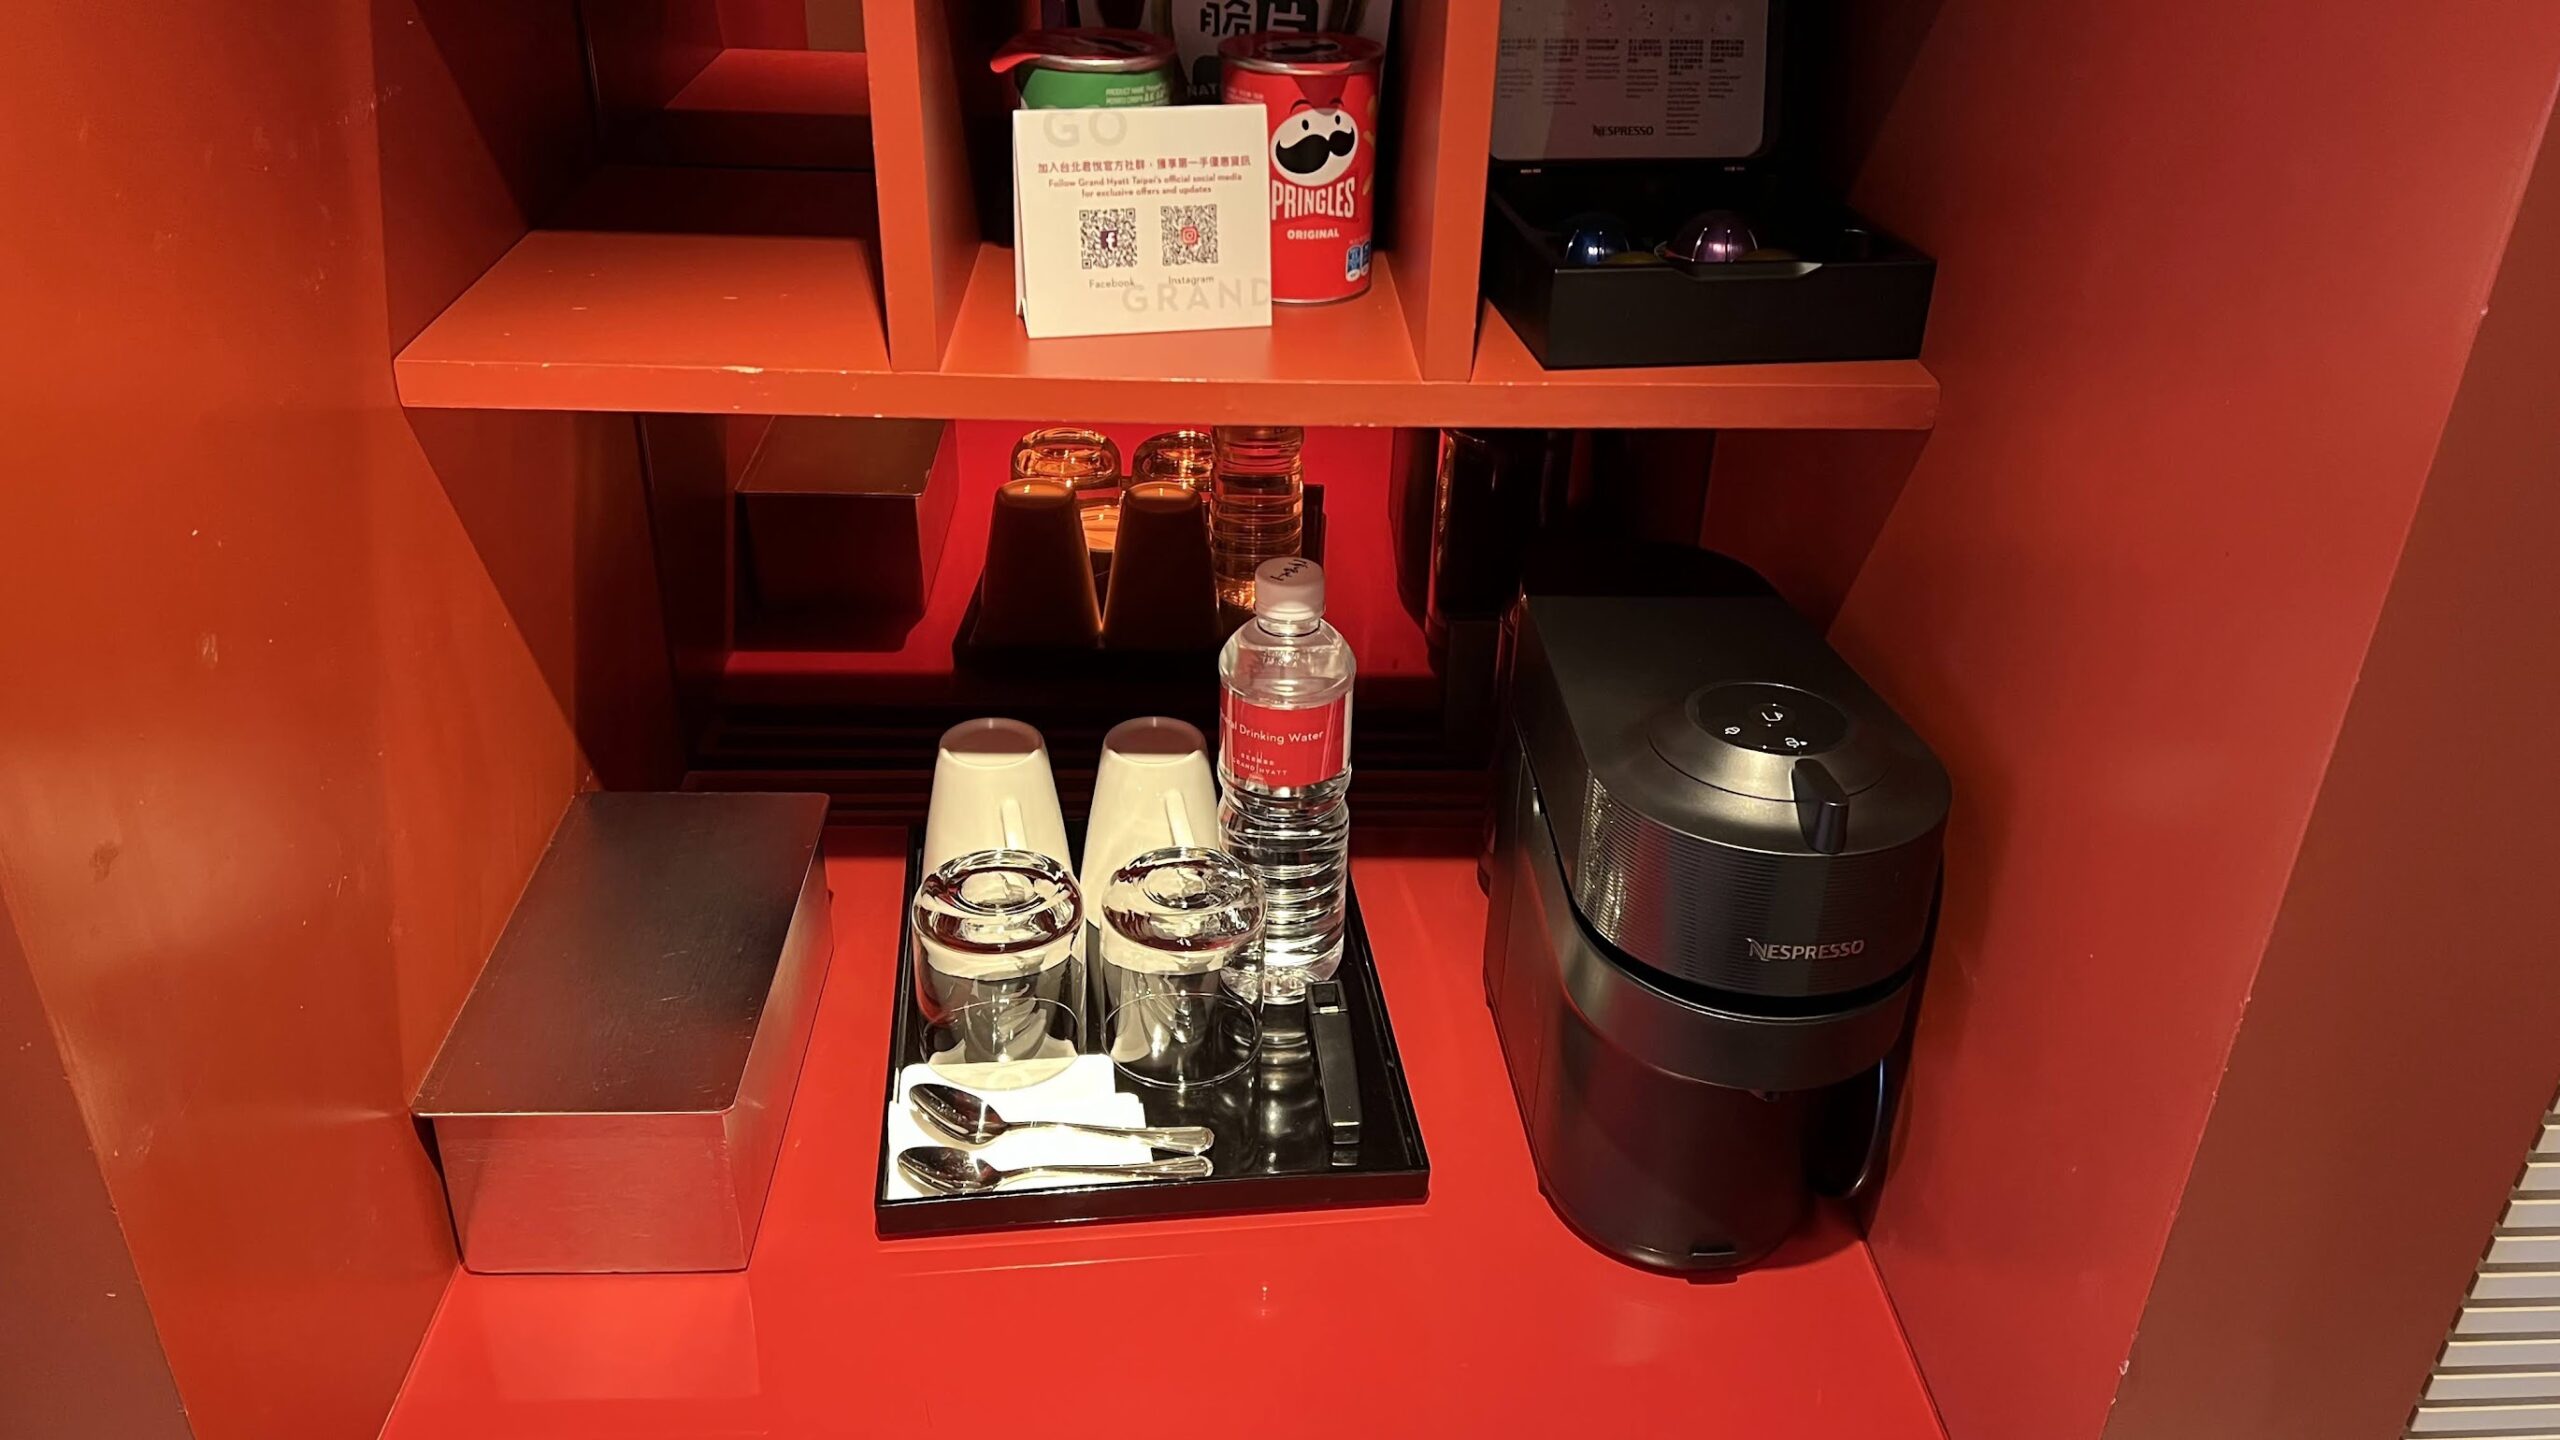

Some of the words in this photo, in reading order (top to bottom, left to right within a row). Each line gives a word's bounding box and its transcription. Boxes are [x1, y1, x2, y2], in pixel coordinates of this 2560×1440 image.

[1043, 110, 1128, 147] GO
[1592, 125, 1655, 137] NESPRESSO
[1048, 178, 1076, 188] Follow
[1078, 177, 1104, 187] Grand
[1106, 177, 1130, 187] Hyatt
[1164, 174, 1190, 183] official
[1193, 173, 1215, 182] social
[1217, 172, 1242, 181] media
[1082, 188, 1094, 198] for
[1096, 188, 1133, 197] exclusive
[1136, 187, 1160, 195] offers
[1162, 185, 1177, 194] and
[1179, 185, 1212, 195] updates
[1271, 176, 1355, 221] PRINGLES
[1287, 228, 1340, 240] ORIGINAL
[1088, 277, 1136, 289] Facebook
[1168, 275, 1215, 287] Instagram
[1121, 277, 1269, 313] GRAND
[1239, 723, 1285, 745] Drinking
[1288, 731, 1324, 743] Water
[1259, 767, 1288, 776] HYATT
[1744, 937, 1865, 962] NESPRESSO
